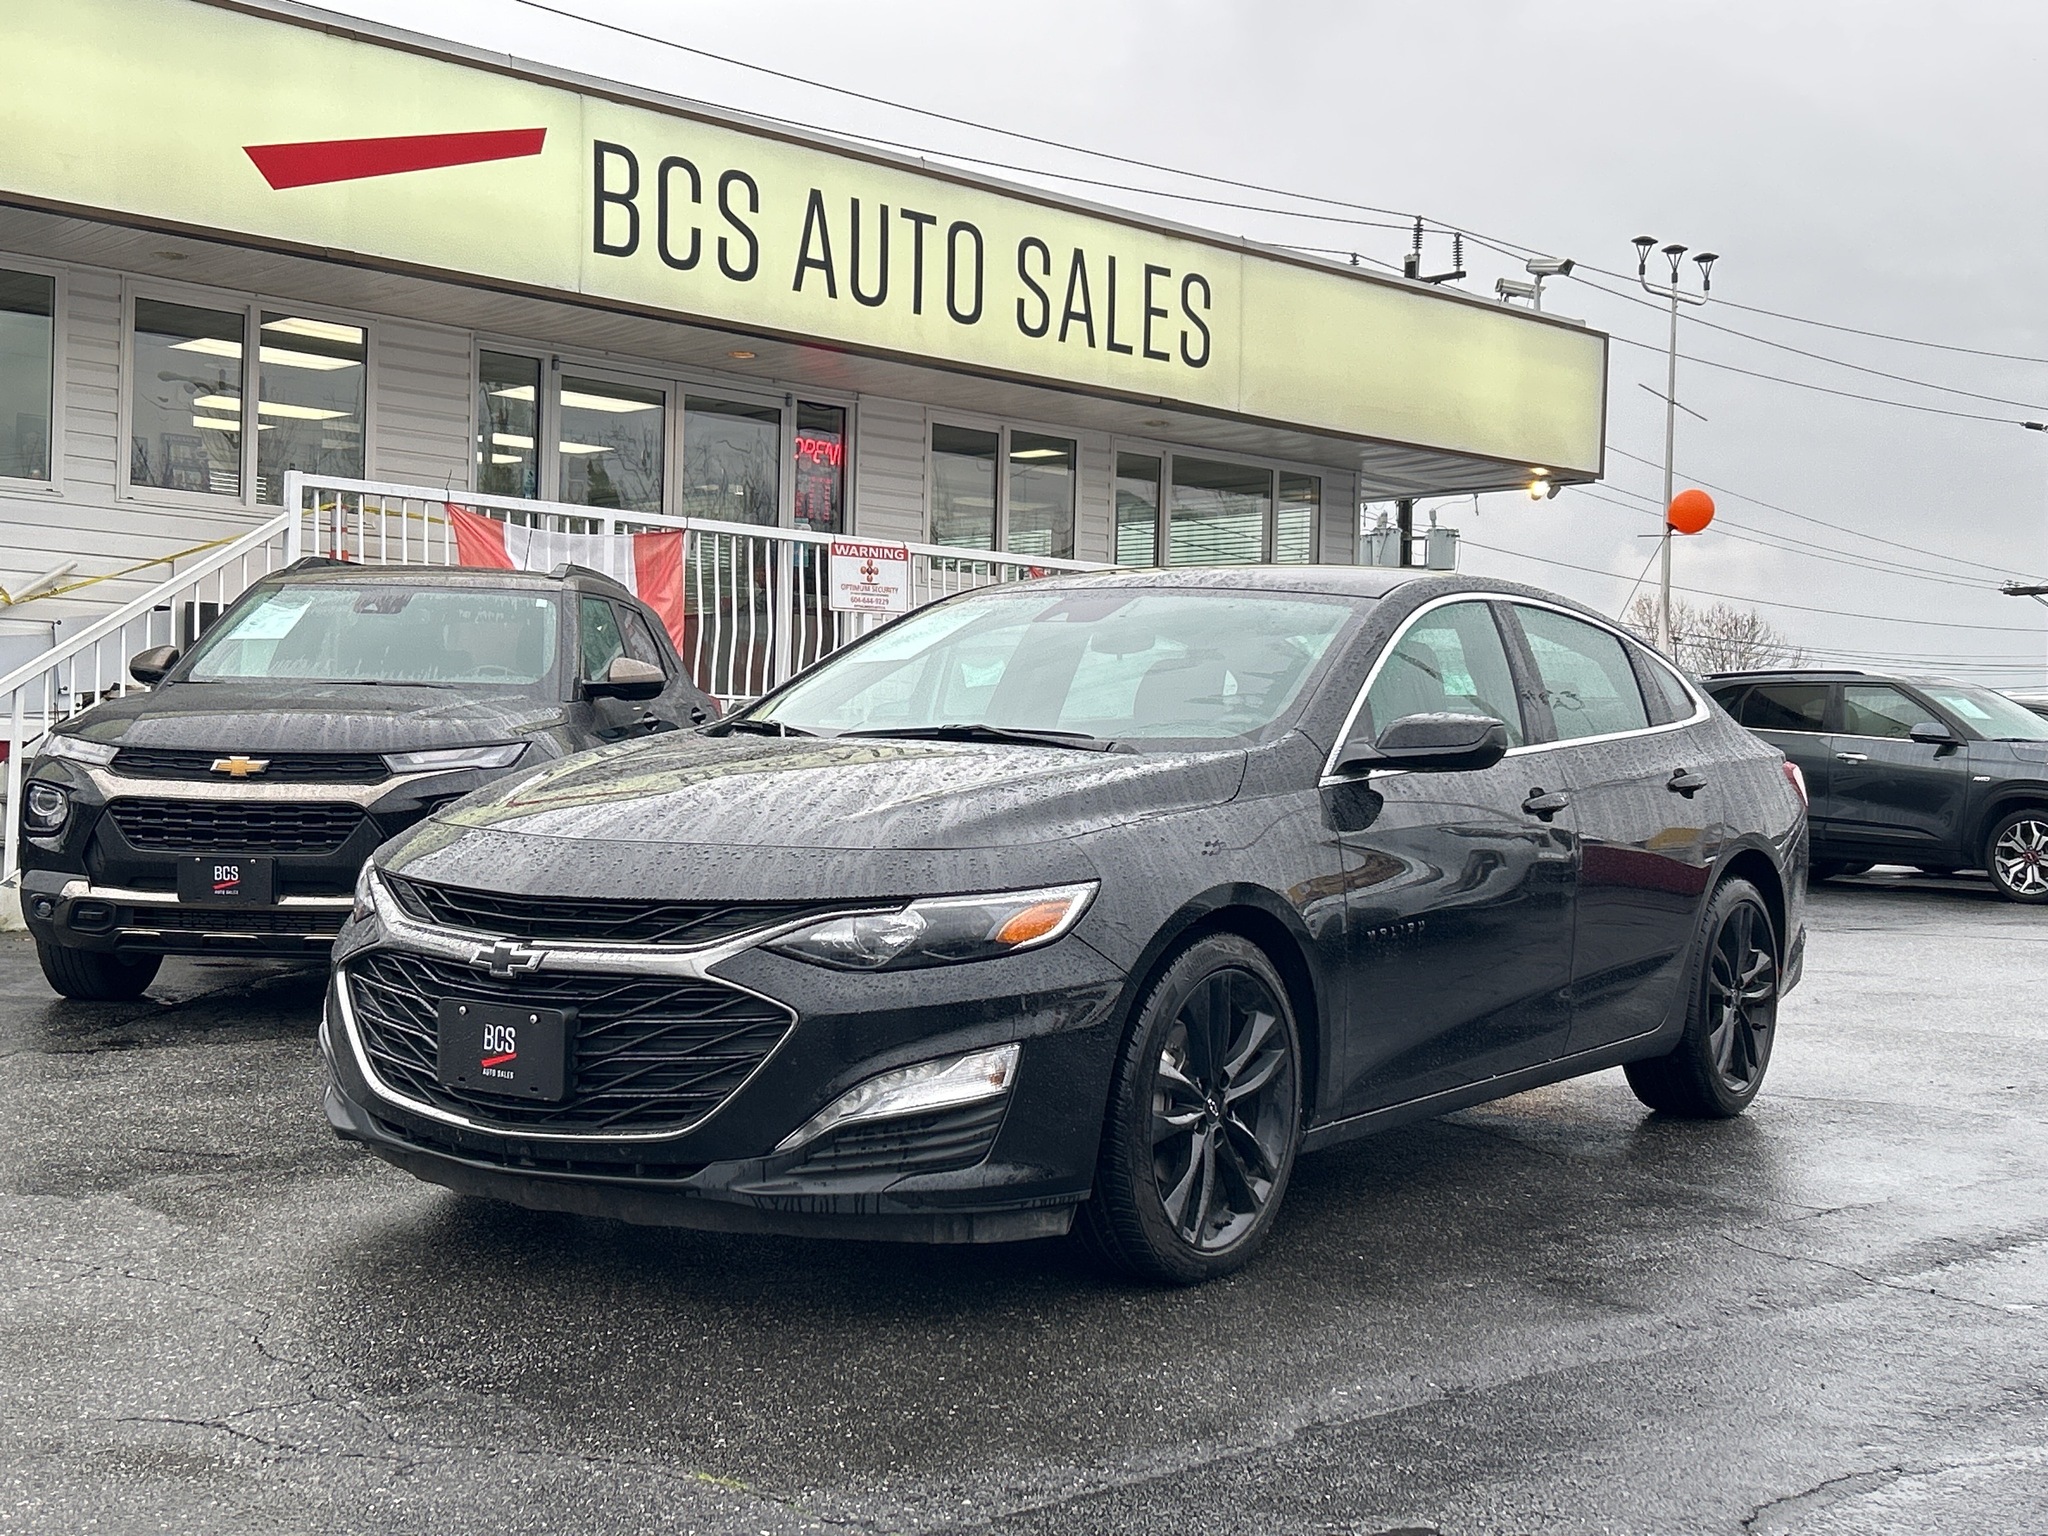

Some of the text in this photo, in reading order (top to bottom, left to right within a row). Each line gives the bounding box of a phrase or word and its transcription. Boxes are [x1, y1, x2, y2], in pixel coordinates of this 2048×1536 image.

[593, 138, 1211, 368] BCS AUTO SALES
[834, 544, 905, 560] WARNING
[840, 583, 899, 594] OPTIMUM SECURITY
[214, 865, 239, 881] BCS
[483, 1023, 516, 1053] BCS
[482, 1068, 514, 1080] AUTO SALES
